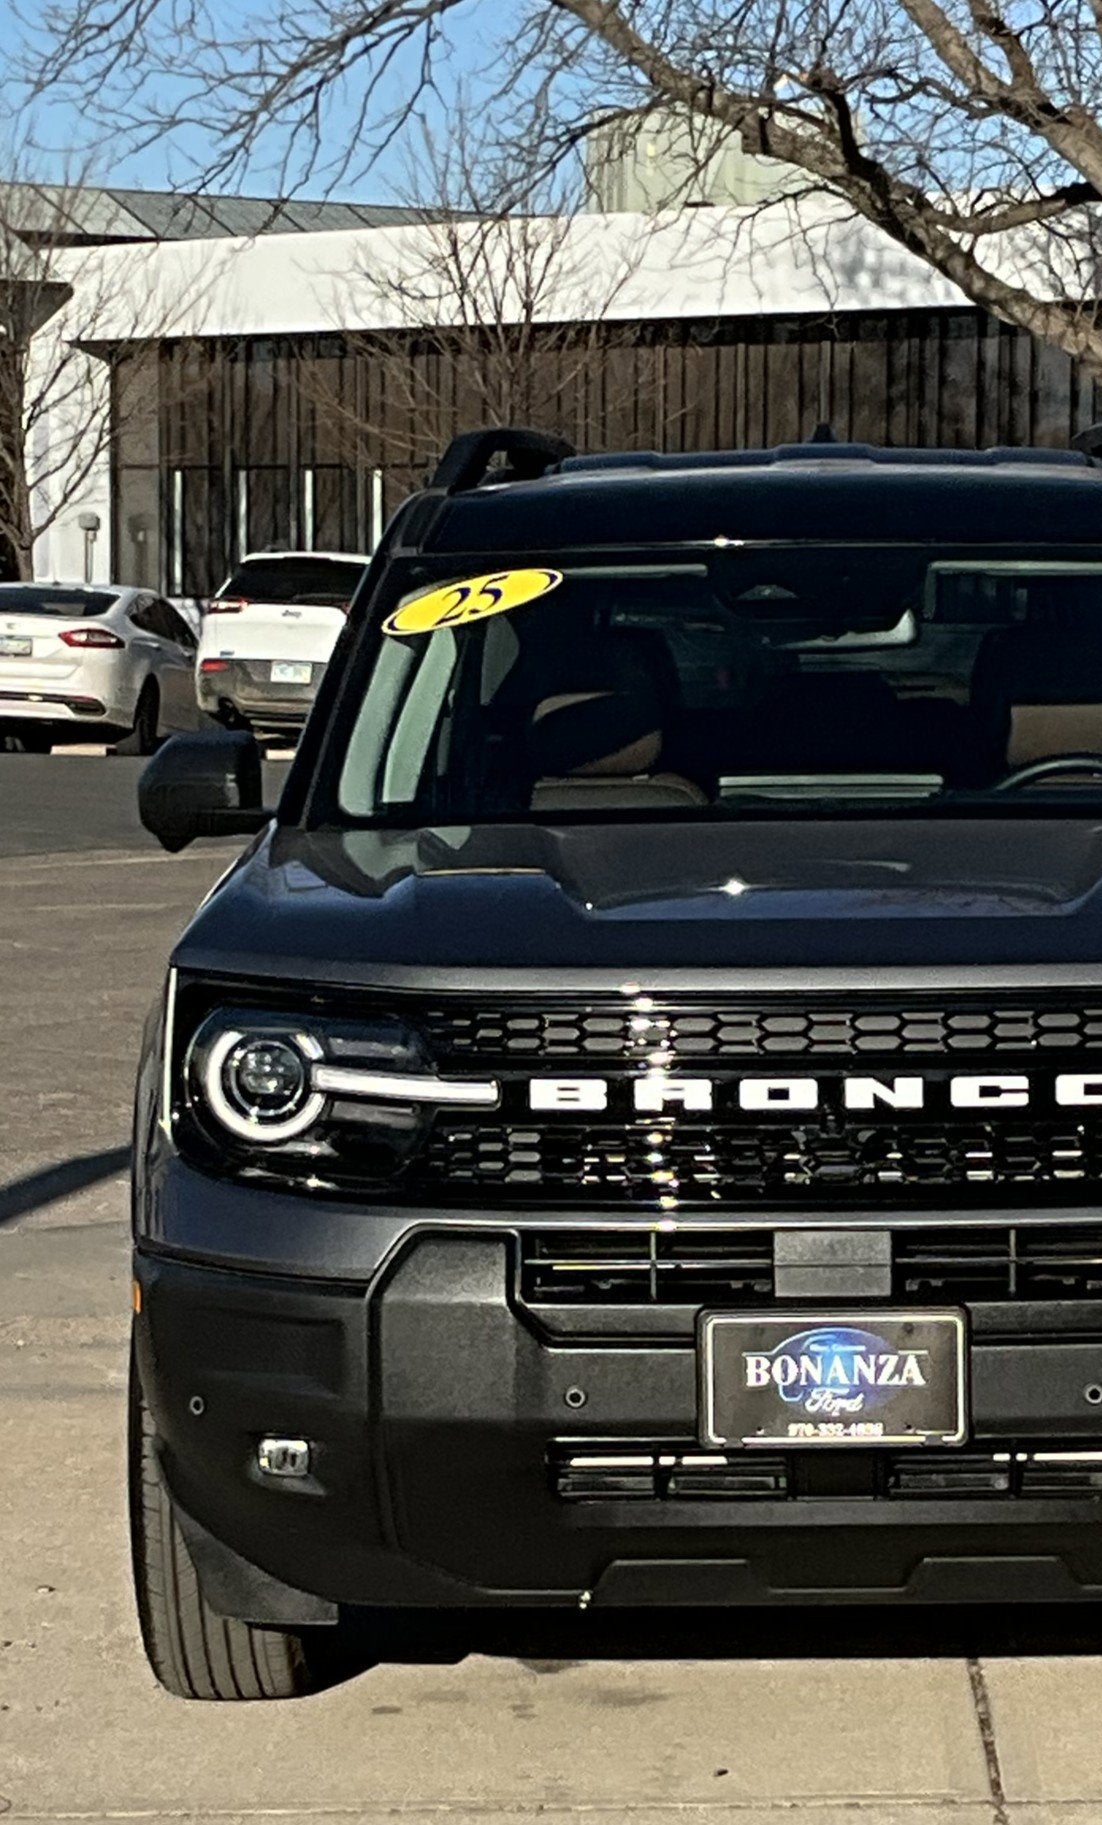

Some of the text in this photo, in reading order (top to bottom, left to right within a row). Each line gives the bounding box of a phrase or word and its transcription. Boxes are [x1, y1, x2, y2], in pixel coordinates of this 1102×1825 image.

[431, 574, 511, 627] 25
[744, 1355, 927, 1387] BONANZA
[804, 1387, 866, 1416] Ford
